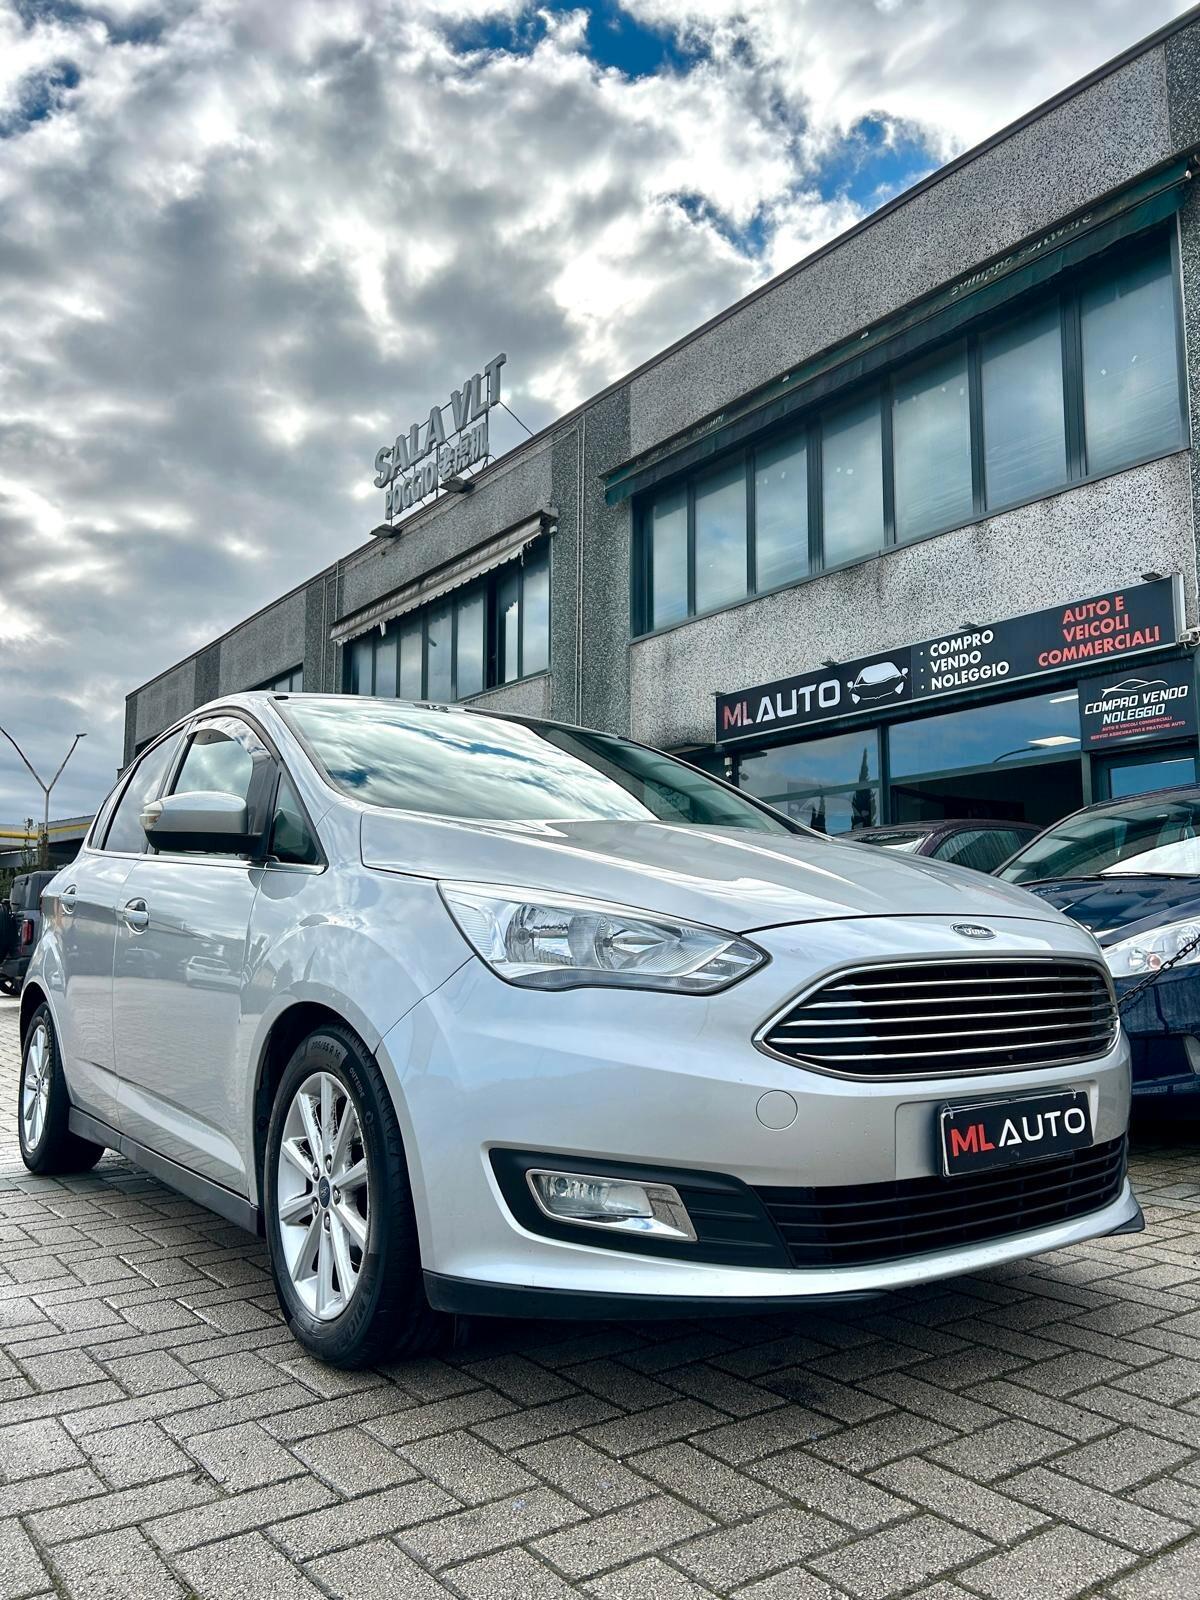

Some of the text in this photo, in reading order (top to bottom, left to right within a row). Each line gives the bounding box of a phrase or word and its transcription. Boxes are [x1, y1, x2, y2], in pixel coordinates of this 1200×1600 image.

[374, 353, 507, 489] SALA VLT
[385, 461, 438, 520] POGGIO
[1062, 596, 1125, 625] AUTO E
[1062, 613, 1130, 642] VEICOLI
[930, 629, 994, 657] COMPRO
[1038, 625, 1160, 667] COMMERCIALI
[930, 650, 982, 673] VENDO
[931, 661, 1010, 690] NOLEGGIO
[723, 679, 841, 730] ML AUTO
[1084, 685, 1188, 715] COMPRO VENDO
[1102, 703, 1166, 725] NOLEGGIO
[951, 1107, 1086, 1158] ML AUTO
